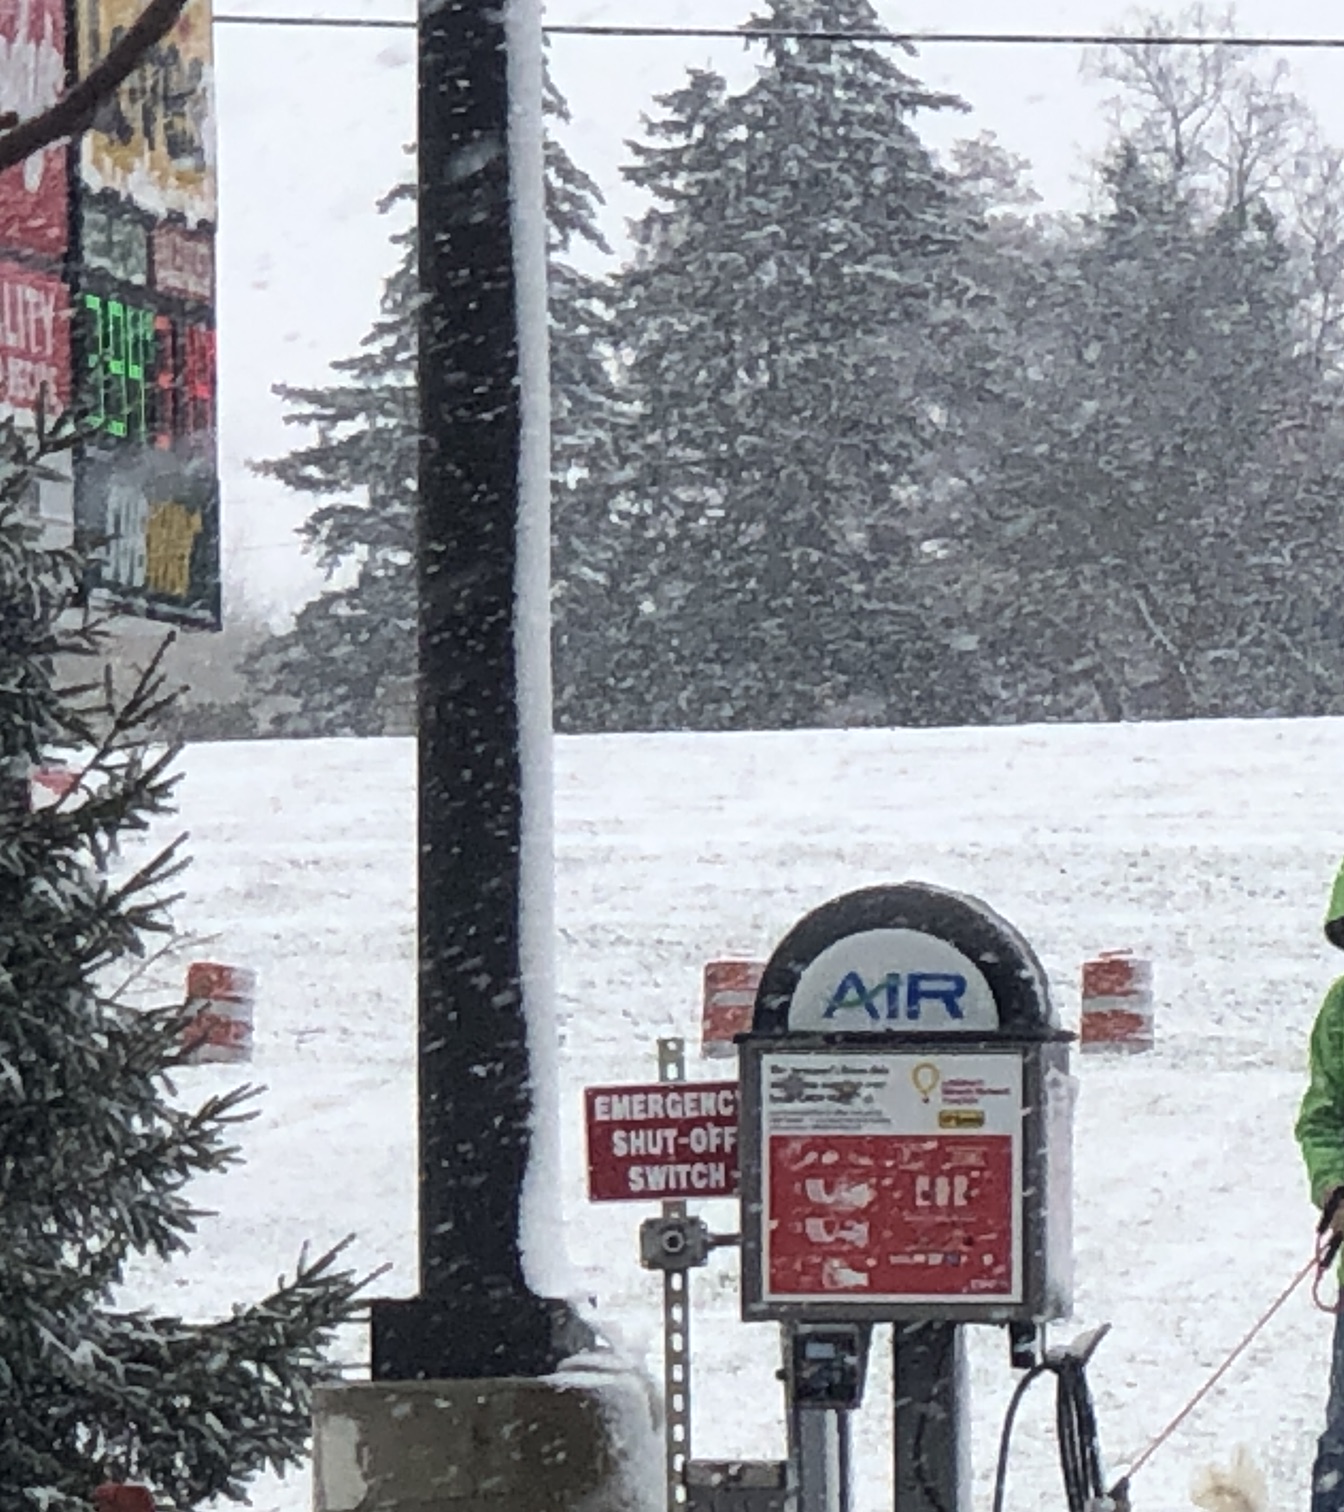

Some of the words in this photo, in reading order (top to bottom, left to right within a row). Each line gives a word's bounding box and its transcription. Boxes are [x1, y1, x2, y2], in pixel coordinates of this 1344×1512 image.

[822, 970, 968, 1020] AIR
[612, 1126, 738, 1157] SHUT-OFF
[628, 1162, 726, 1191] SWITCH
